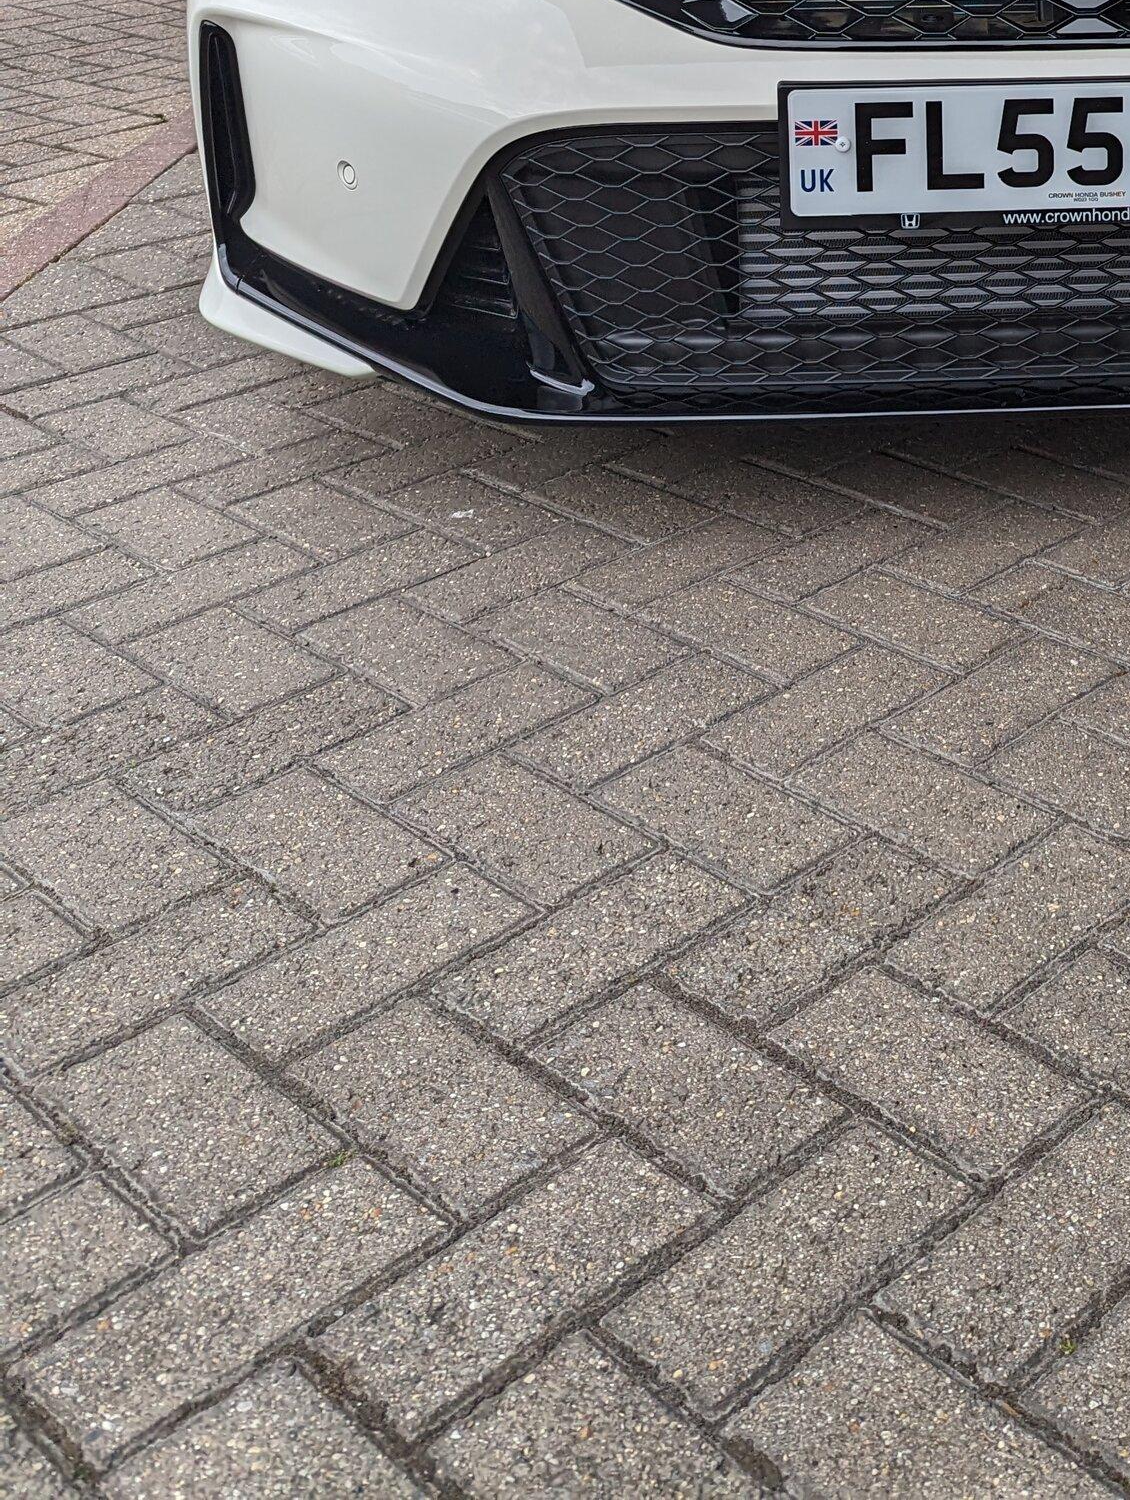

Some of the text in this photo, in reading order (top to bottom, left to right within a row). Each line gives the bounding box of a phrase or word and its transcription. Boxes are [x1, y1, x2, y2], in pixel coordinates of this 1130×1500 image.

[855, 96, 1124, 192] FL55
[800, 168, 835, 193] UK
[1100, 190, 1127, 198] BUSHEY
